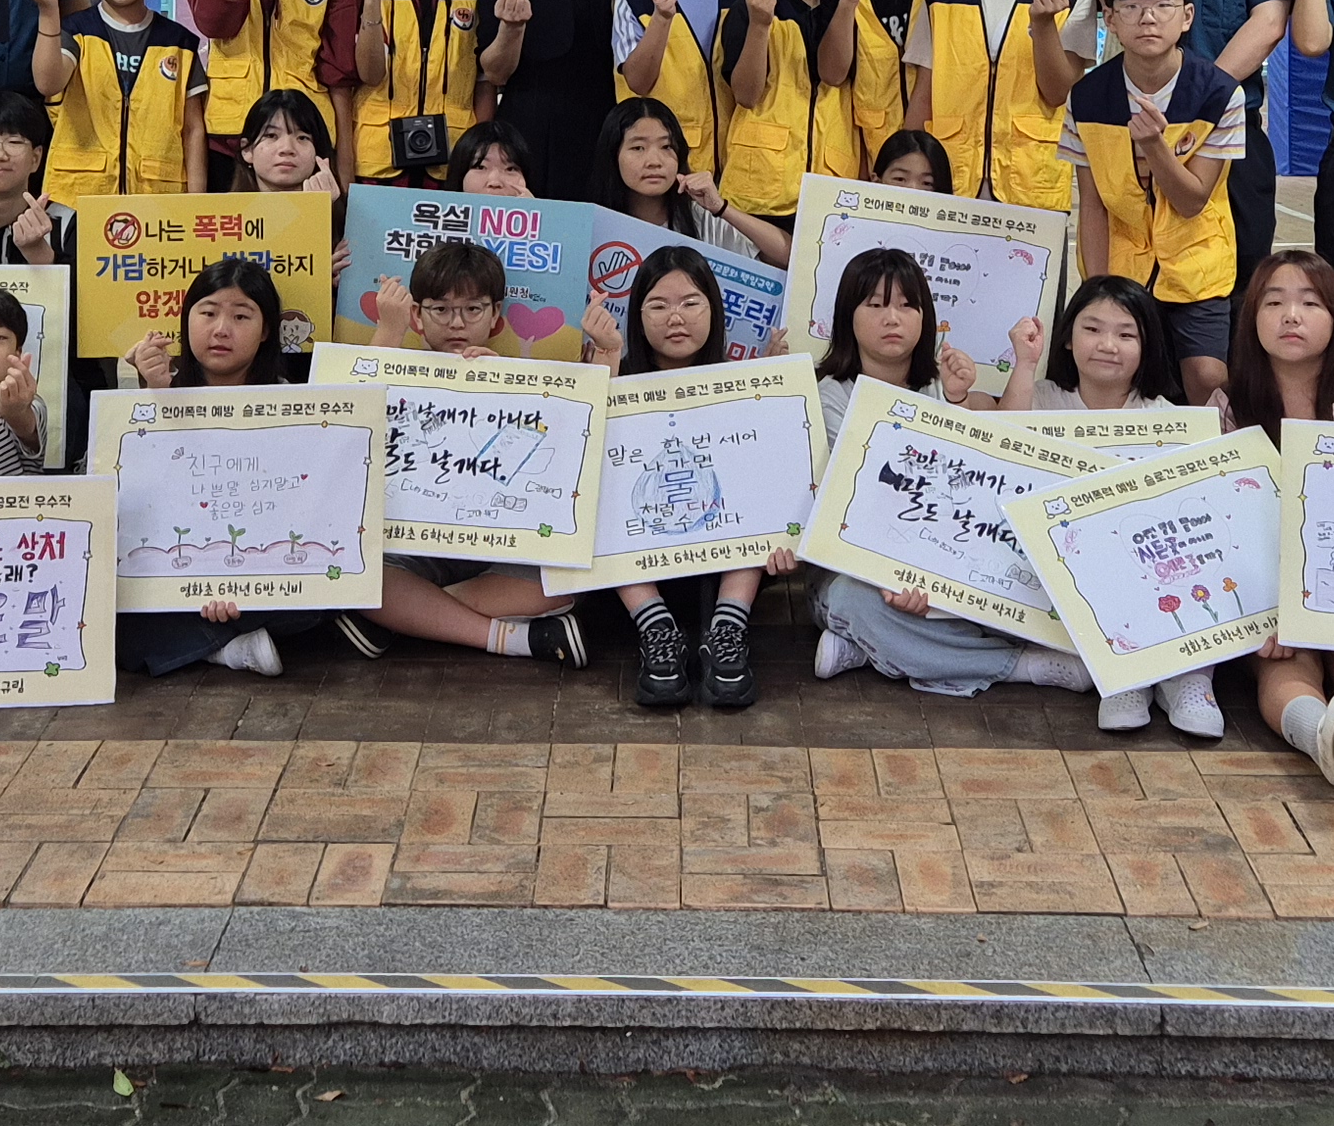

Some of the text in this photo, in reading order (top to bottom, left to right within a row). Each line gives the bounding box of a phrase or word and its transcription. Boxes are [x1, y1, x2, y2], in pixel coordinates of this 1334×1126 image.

[145, 214, 264, 242] 나는 폭력에
[412, 203, 538, 239] 욕설 NO!
[863, 197, 1037, 234] 언어폭력 예방 슬로건 공모전 우수작
[483, 238, 560, 272] YES!
[644, 375, 783, 403] 예방 슬로건 공모전 우수작
[608, 445, 644, 467] 말은
[661, 437, 683, 453] 한
[692, 433, 711, 449] 번
[35, 494, 72, 509] 우수작
[659, 469, 698, 504] 물
[640, 497, 725, 517] 처럼 다시
[625, 512, 744, 536] 담을 수 없다
[17, 531, 66, 561] 상처
[635, 540, 772, 570] 영화초 6학년 6반 강민아
[16, 584, 65, 649] 말
[1179, 636, 1212, 656] 영화초
[1213, 627, 1243, 645] 6학년
[1245, 620, 1261, 639] 1반
